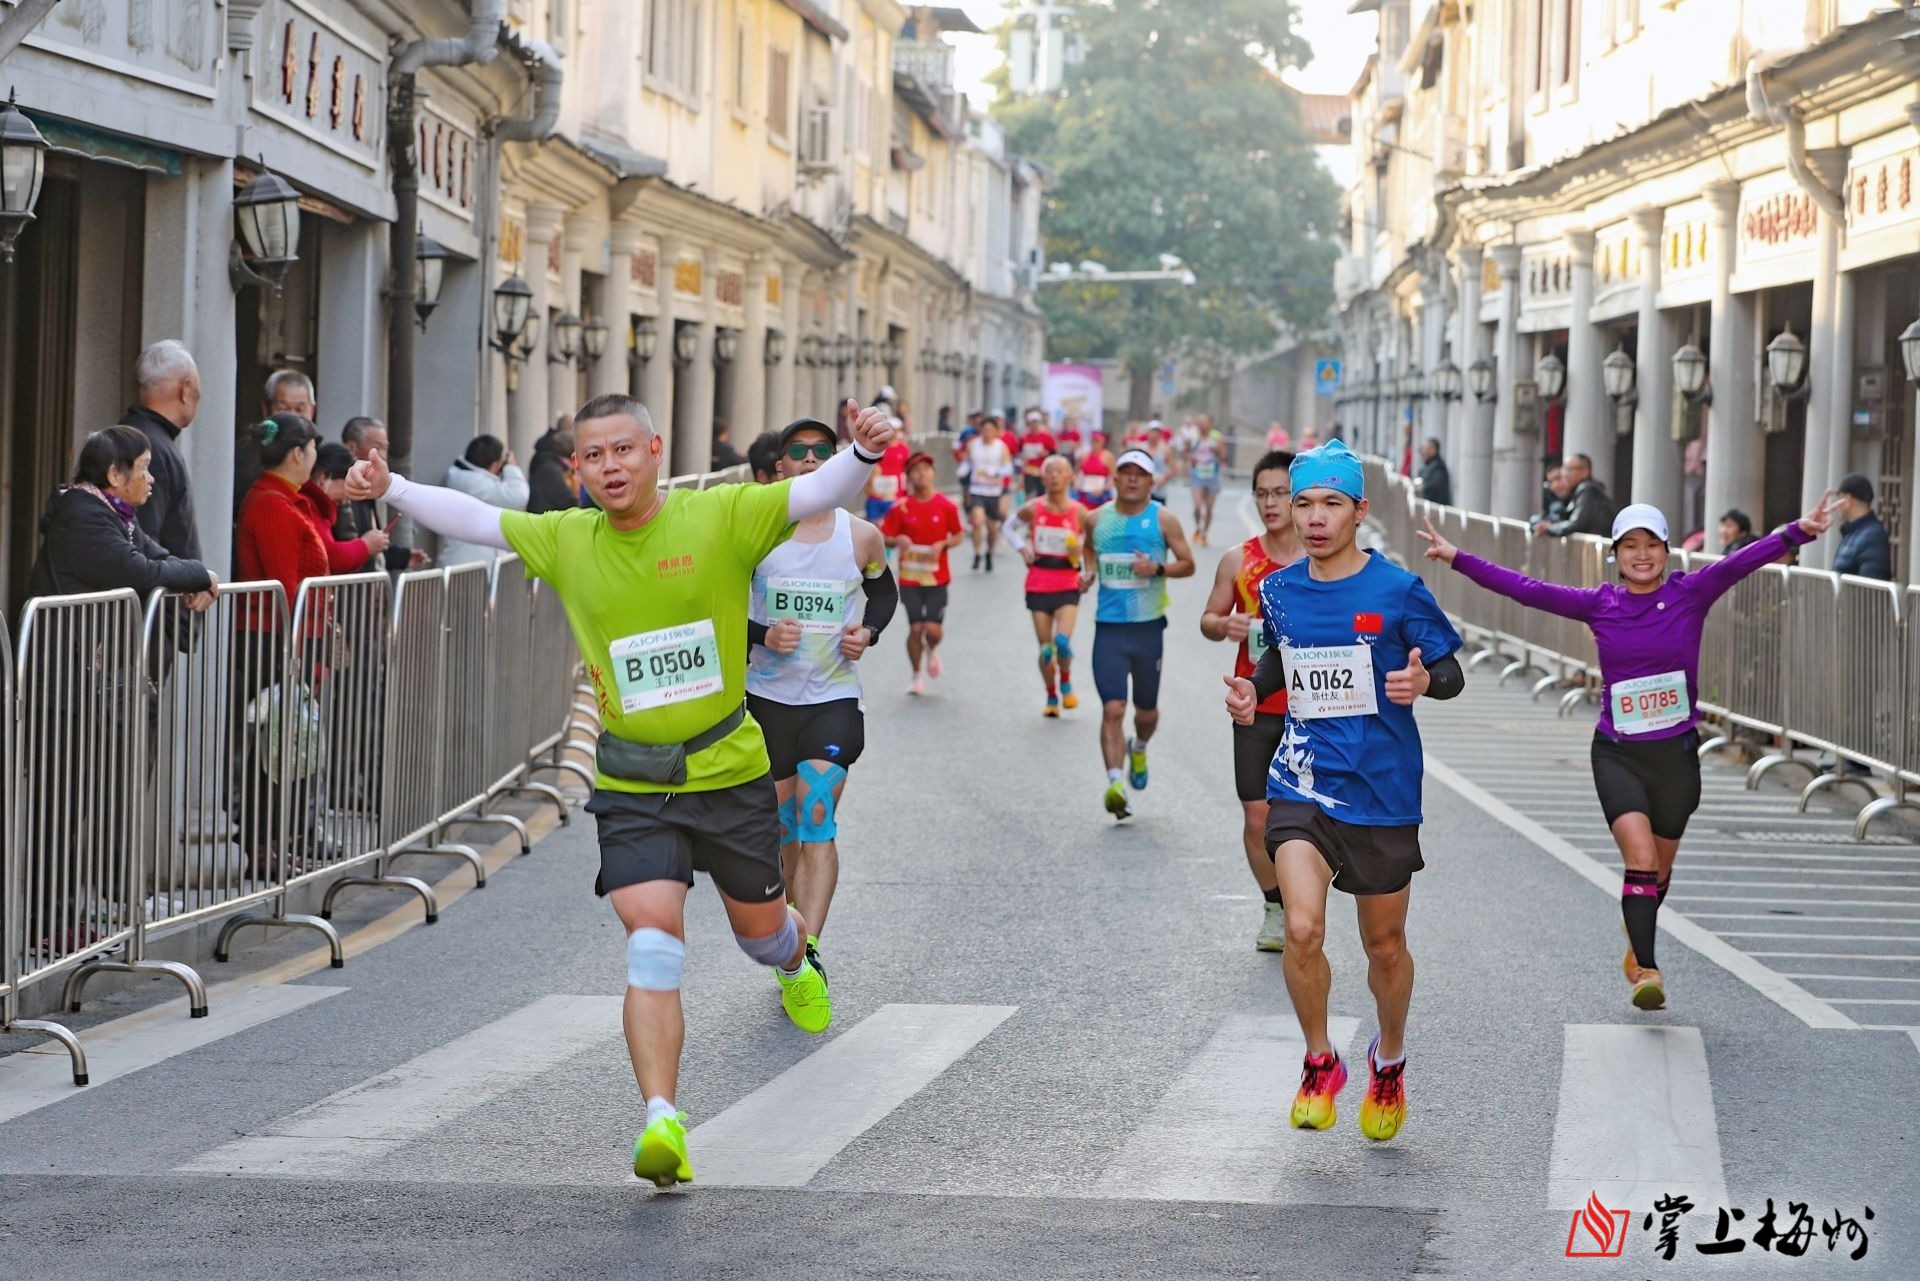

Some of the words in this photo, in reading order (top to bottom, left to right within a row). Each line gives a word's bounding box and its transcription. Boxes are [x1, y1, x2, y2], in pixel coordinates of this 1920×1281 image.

[1106, 563, 1113, 576] B
[775, 593, 788, 610] B
[794, 595, 834, 613] 0394
[626, 658, 644, 683] B
[649, 645, 705, 677] 0506
[1292, 669, 1304, 691] A
[1309, 669, 1354, 691] 0162
[1620, 695, 1634, 714] B
[1639, 689, 1679, 711] 0785
